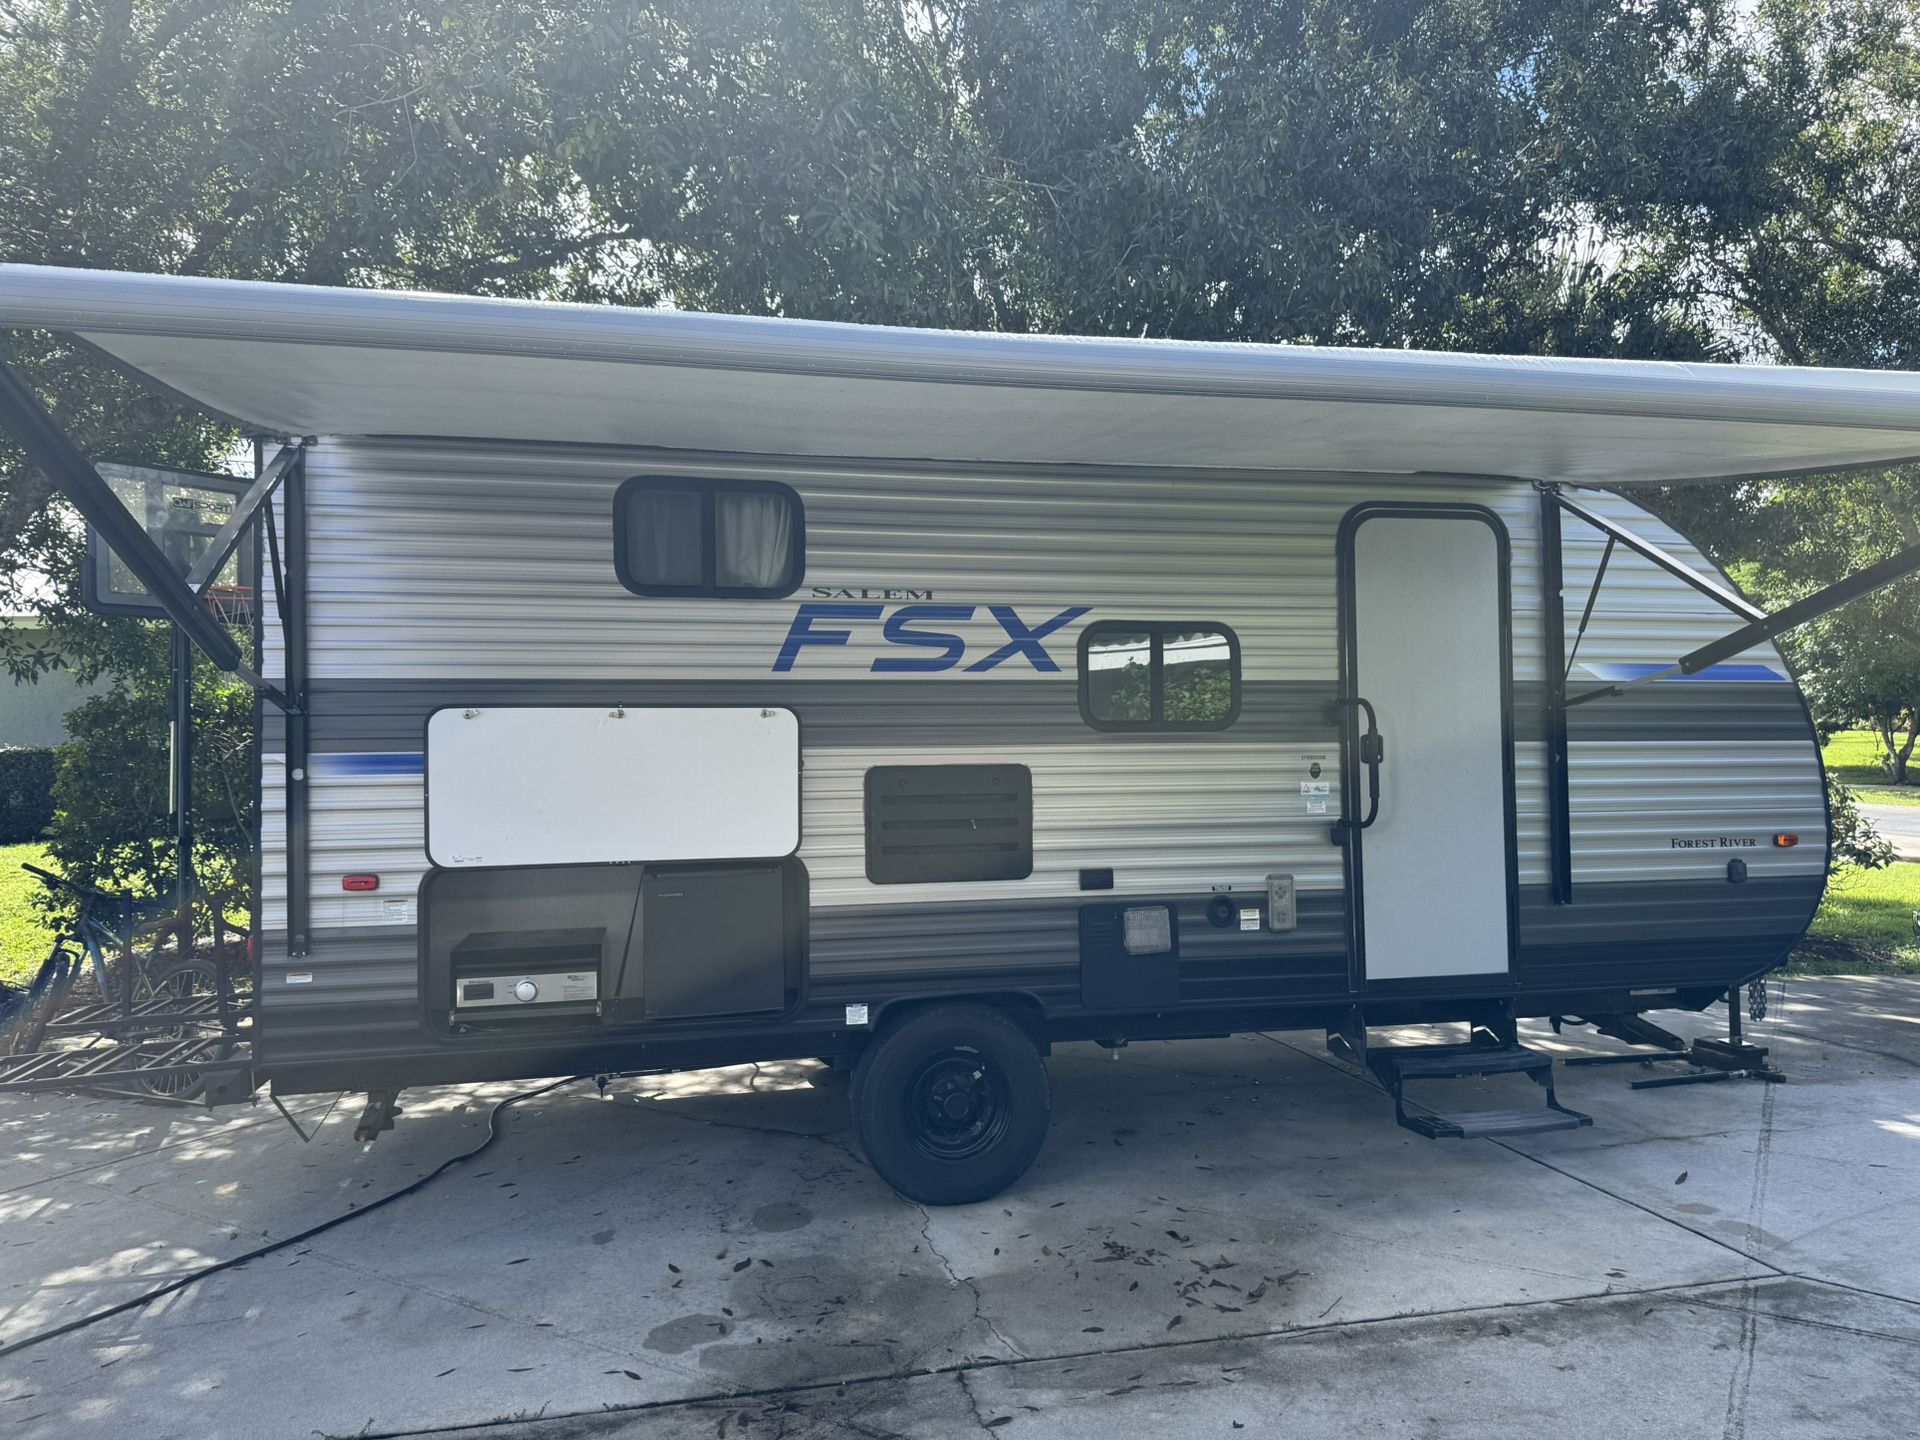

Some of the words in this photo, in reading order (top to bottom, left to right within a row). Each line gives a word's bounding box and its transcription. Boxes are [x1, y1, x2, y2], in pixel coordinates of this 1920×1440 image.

[194, 501, 230, 513] SPORT
[811, 586, 933, 600] SALEM
[771, 604, 1095, 672] FSX
[1671, 838, 1717, 849] FOREST
[1720, 837, 1756, 848] RIVER
